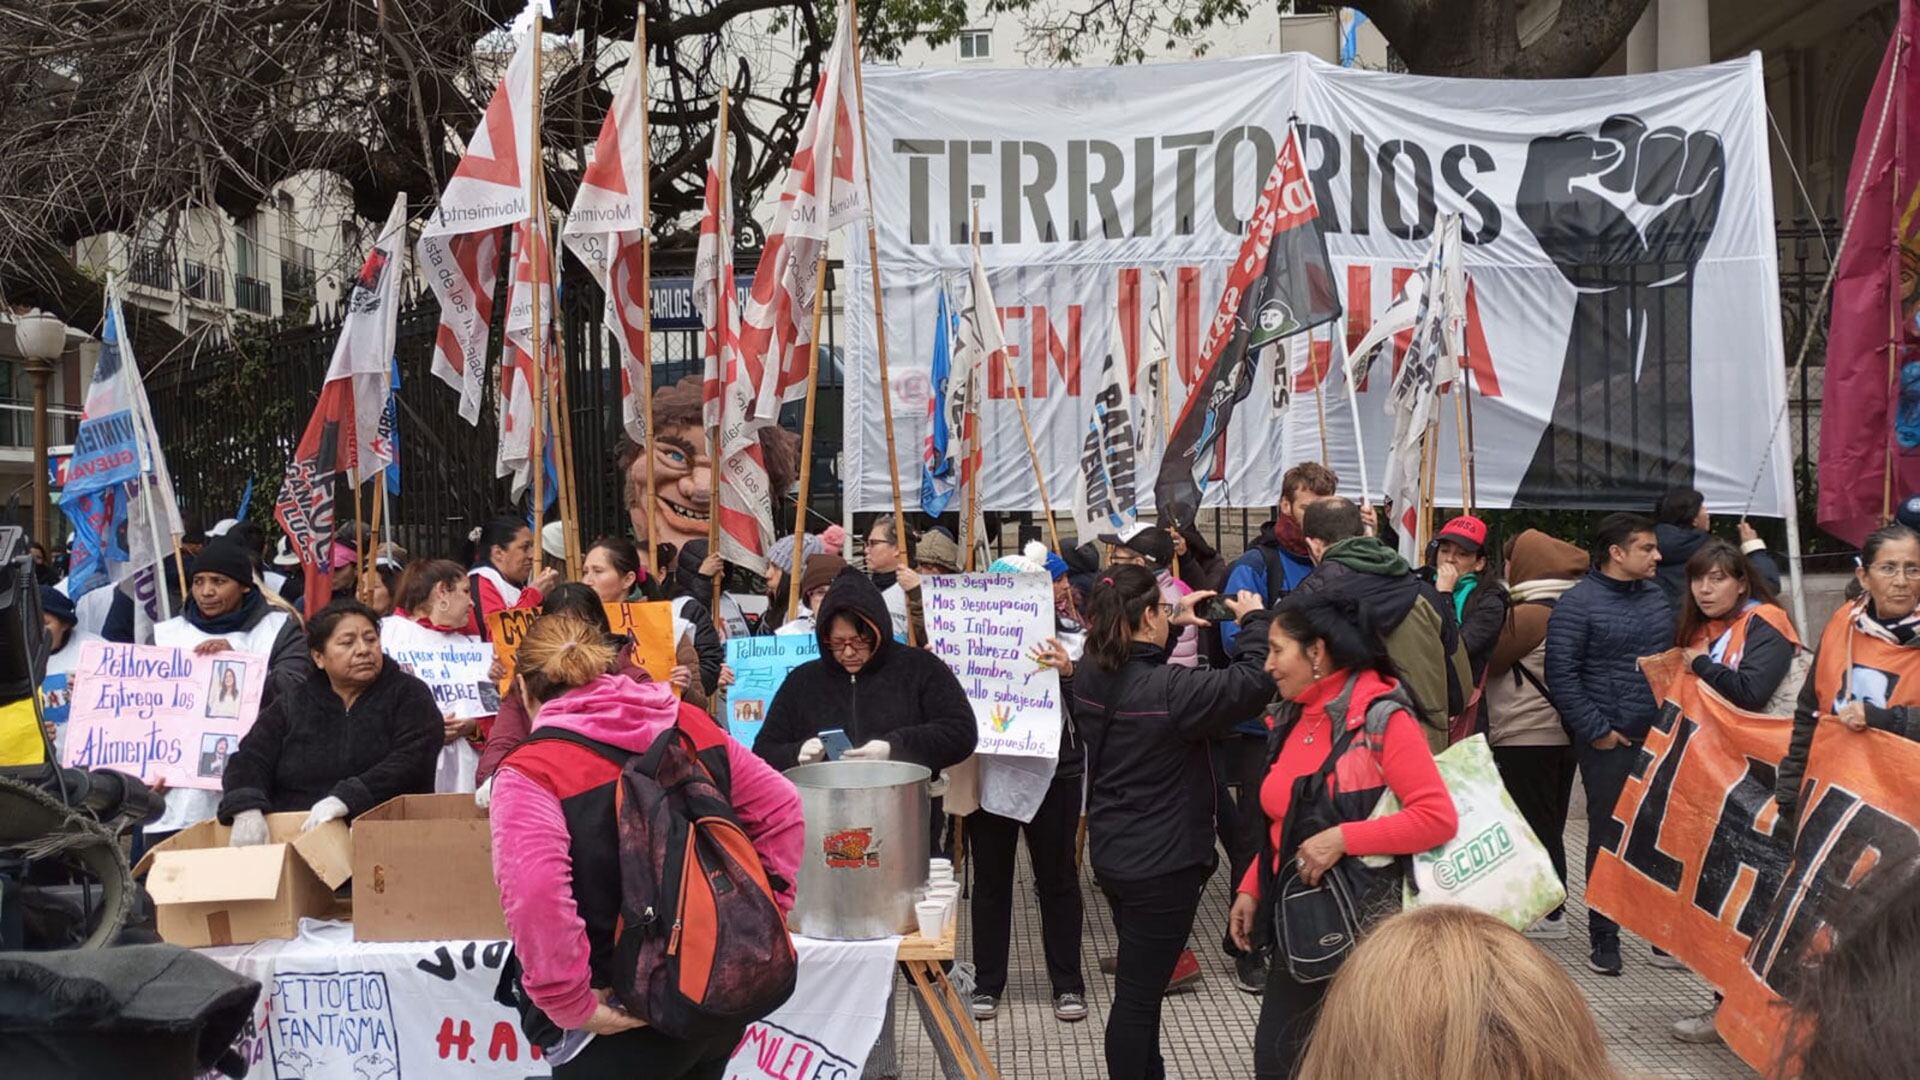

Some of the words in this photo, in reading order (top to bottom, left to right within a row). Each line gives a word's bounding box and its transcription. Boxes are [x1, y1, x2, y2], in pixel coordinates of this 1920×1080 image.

[893, 125, 1502, 246] TERRITORIOS
[988, 305, 1082, 399] EN
[968, 637, 1019, 660] Pobreza
[171, 682, 195, 709] los
[71, 721, 183, 778] Alimentos
[278, 1014, 391, 1055] FANTASMA
